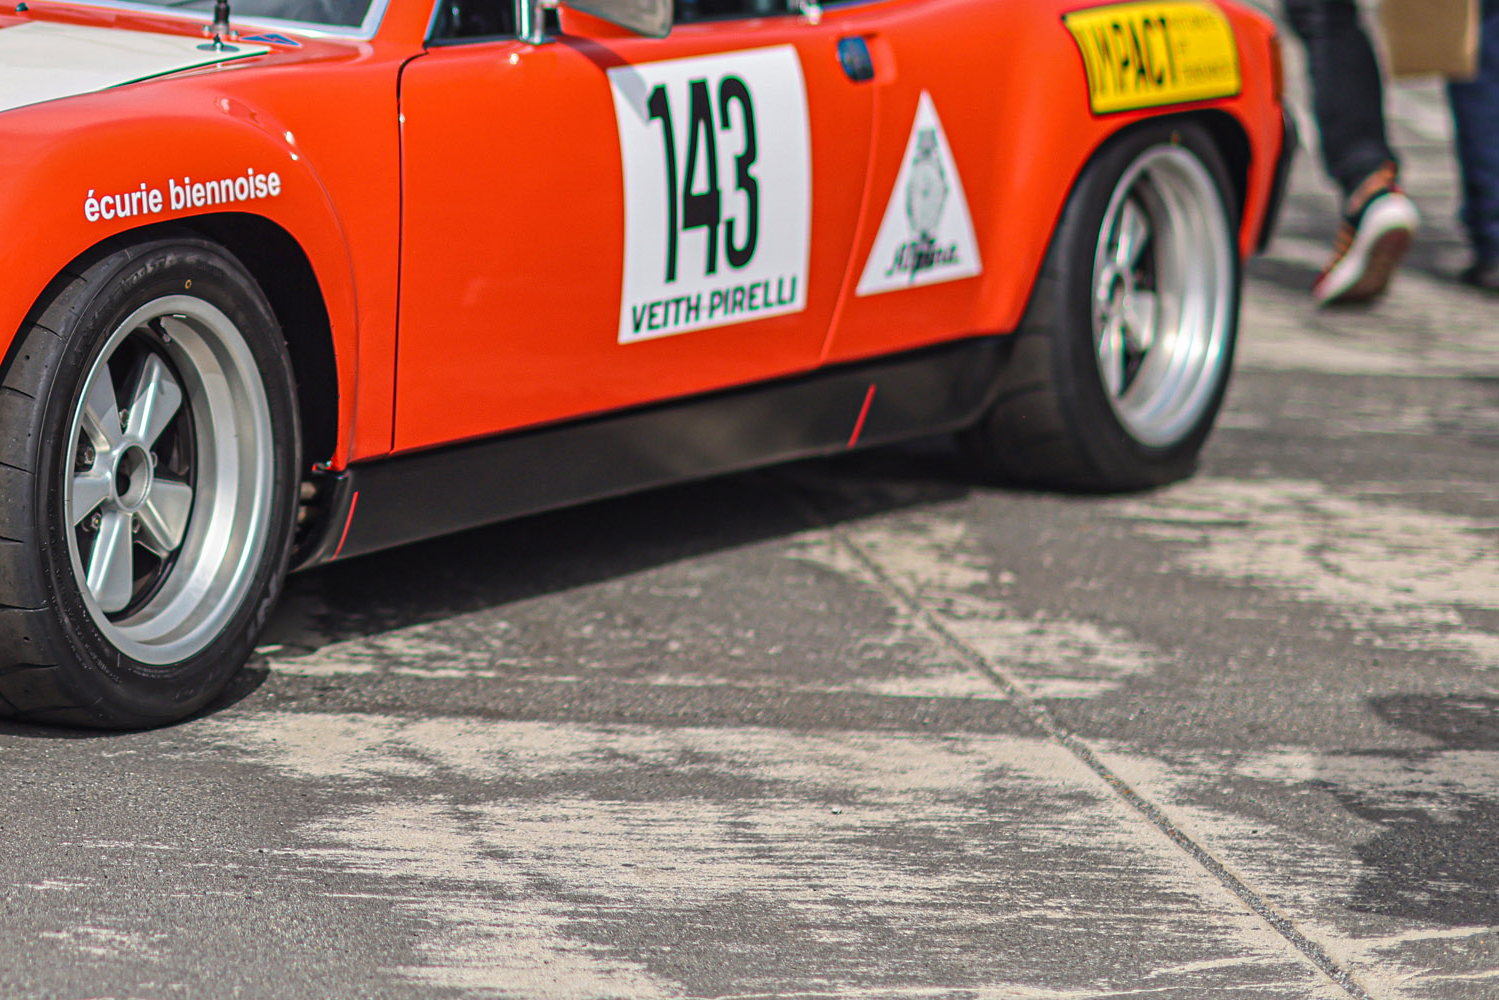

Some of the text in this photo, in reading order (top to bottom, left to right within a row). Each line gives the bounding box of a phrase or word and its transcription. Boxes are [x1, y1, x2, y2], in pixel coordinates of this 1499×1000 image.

[84, 167, 281, 222] écurie biennoise
[646, 73, 760, 284] 143
